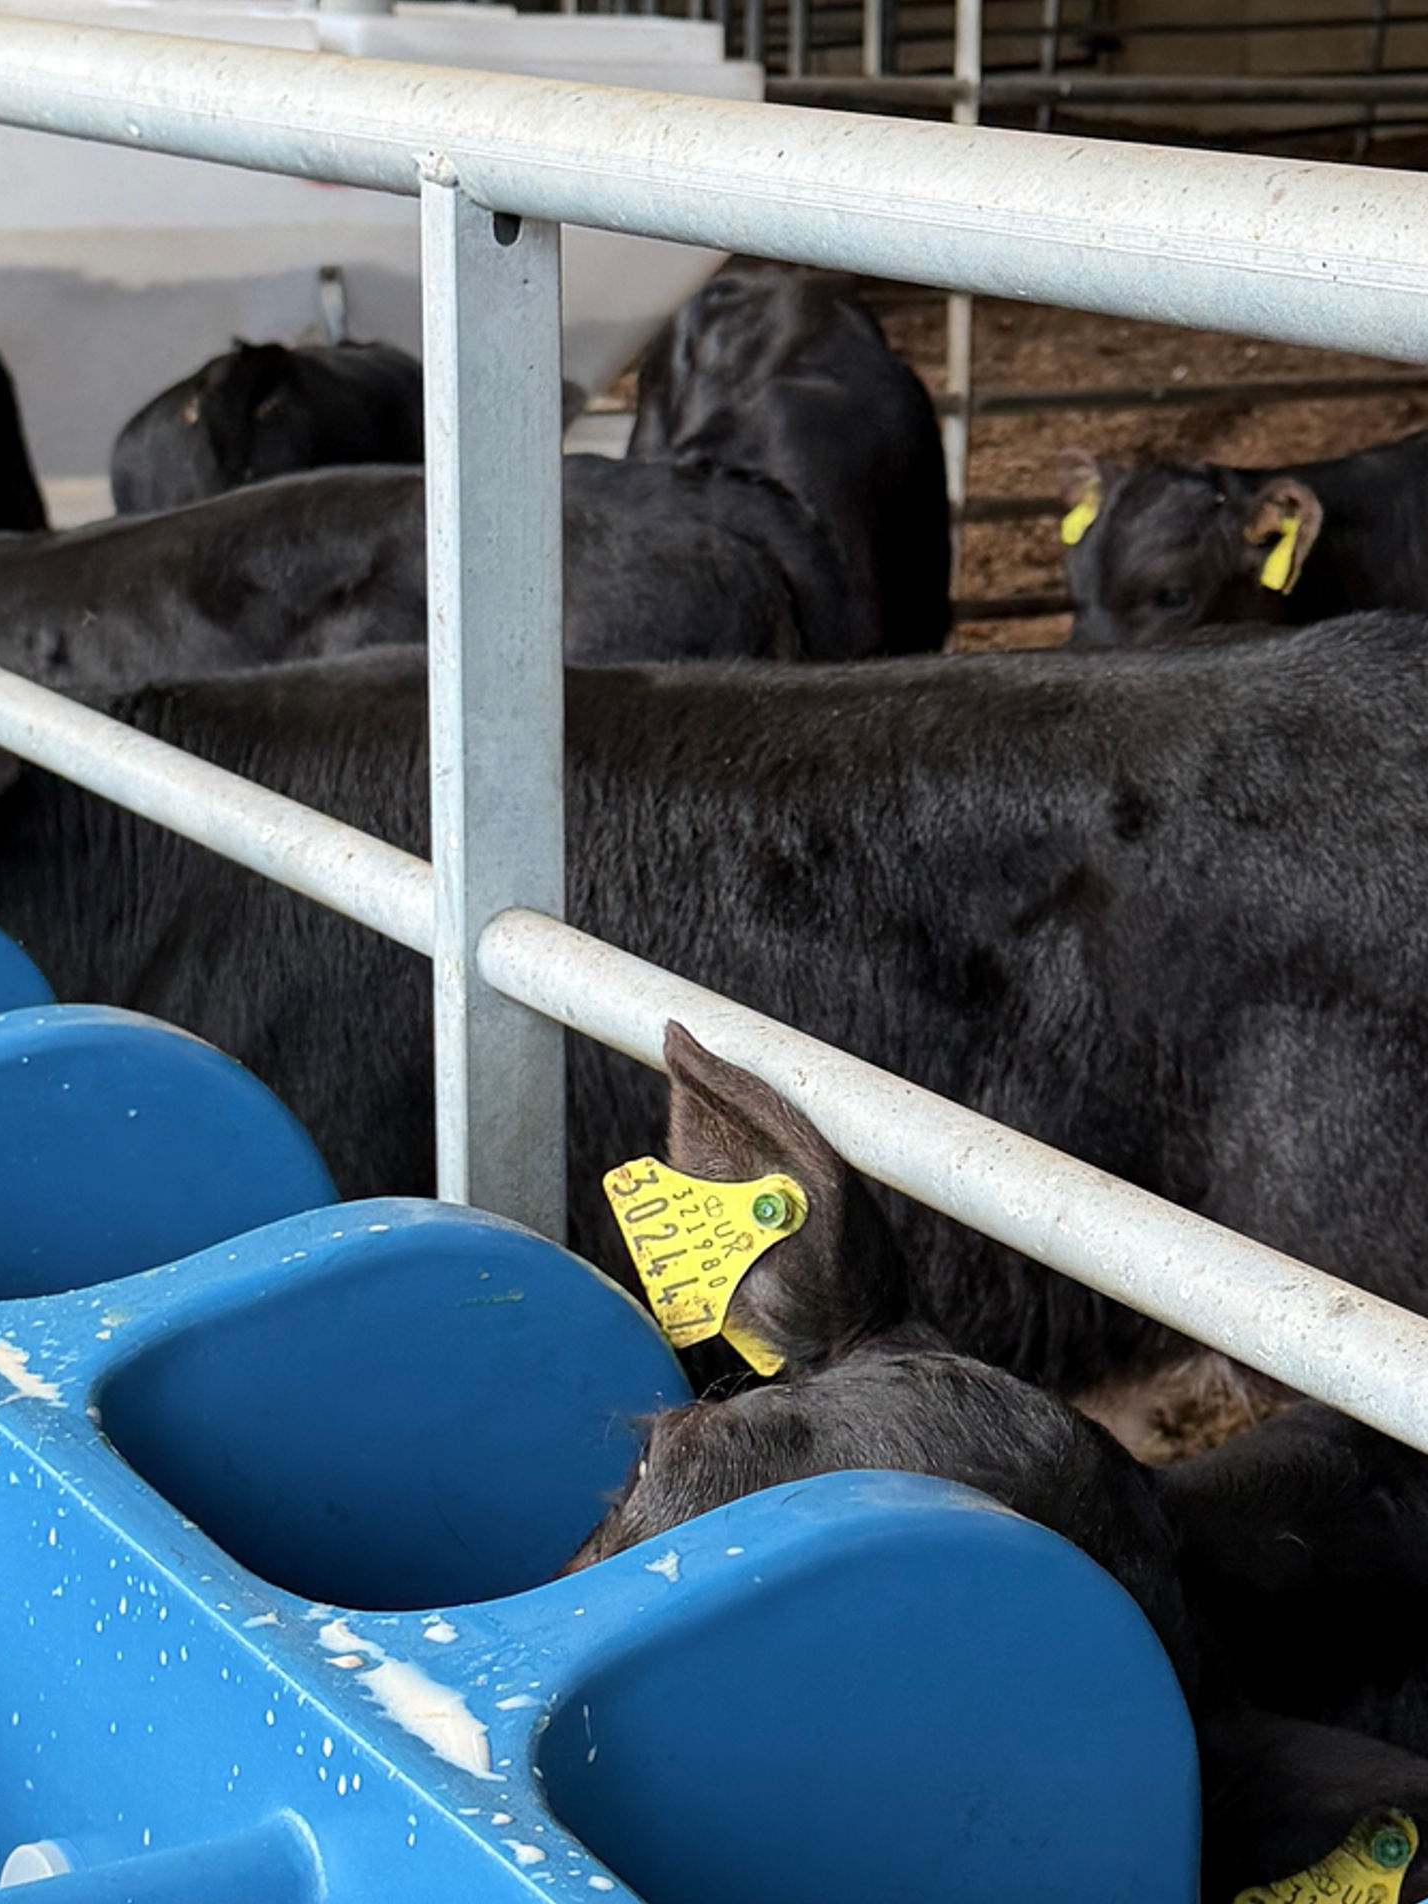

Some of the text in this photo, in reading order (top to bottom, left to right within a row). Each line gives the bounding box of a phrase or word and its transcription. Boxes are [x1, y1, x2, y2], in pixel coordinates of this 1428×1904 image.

[612, 1169, 715, 1333] 302447
[672, 1187, 729, 1290] 321980
[713, 1220, 747, 1260] UK
